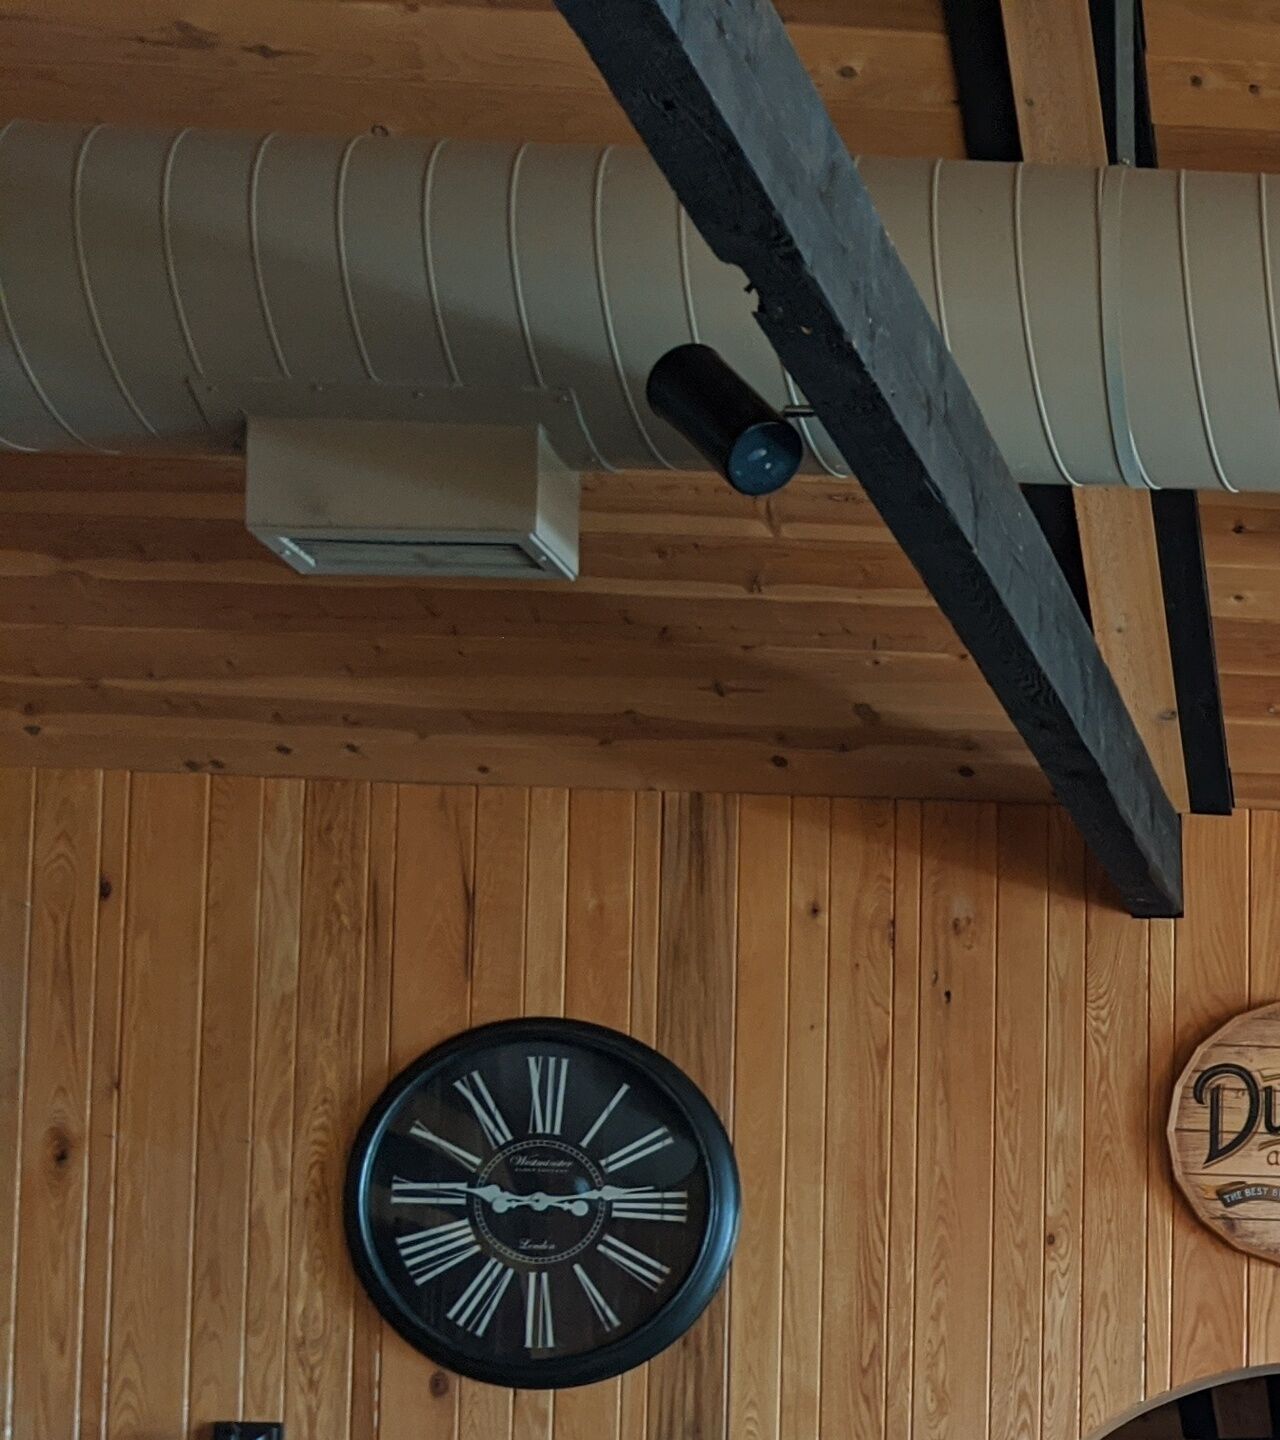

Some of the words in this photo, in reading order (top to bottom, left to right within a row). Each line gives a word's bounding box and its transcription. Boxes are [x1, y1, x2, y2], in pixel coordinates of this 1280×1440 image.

[526, 1056, 569, 1135] XII
[1224, 1191, 1242, 1204] THE
[1244, 1187, 1268, 1197] BEST
